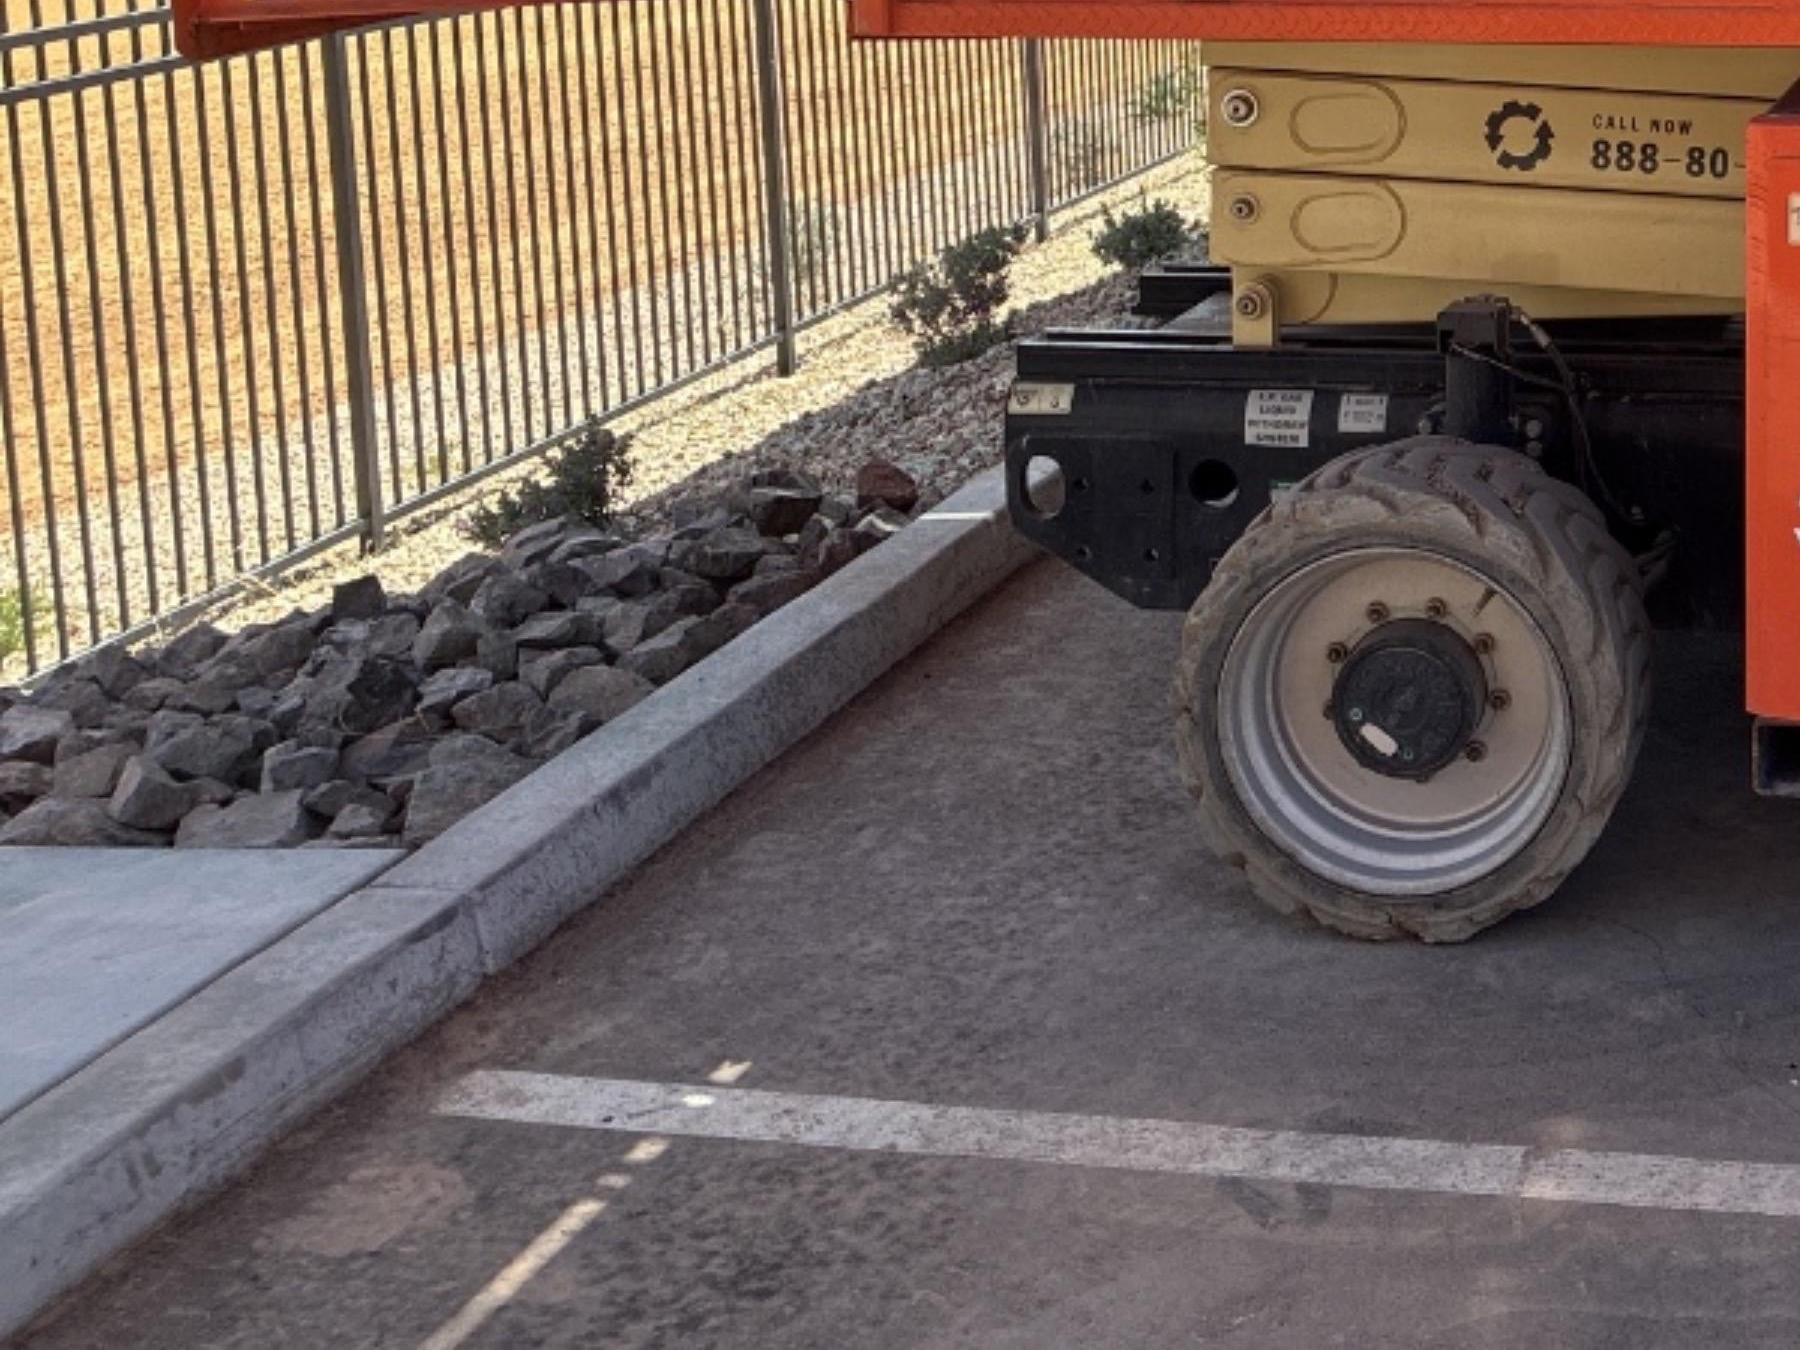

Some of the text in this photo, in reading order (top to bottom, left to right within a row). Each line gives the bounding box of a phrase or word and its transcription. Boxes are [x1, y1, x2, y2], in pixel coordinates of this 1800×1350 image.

[1592, 114, 1693, 136] CALL NOW
[1591, 138, 1746, 179] 888-80
